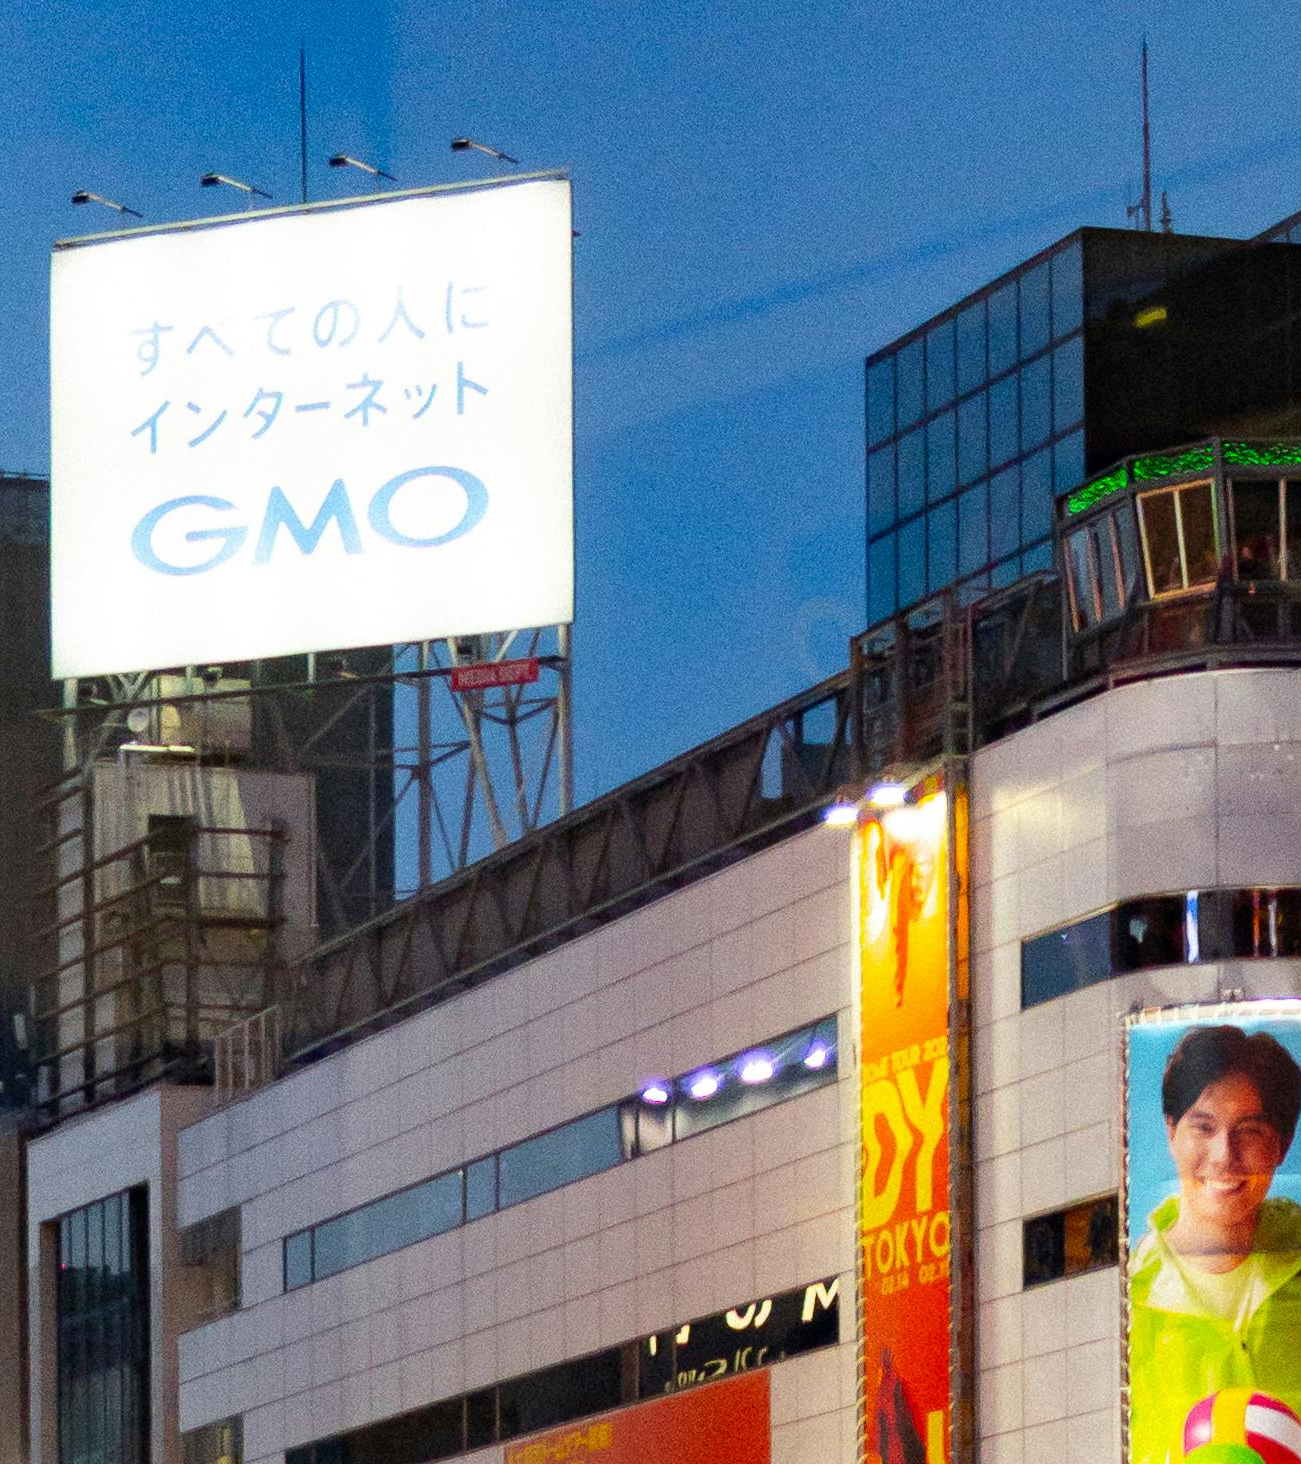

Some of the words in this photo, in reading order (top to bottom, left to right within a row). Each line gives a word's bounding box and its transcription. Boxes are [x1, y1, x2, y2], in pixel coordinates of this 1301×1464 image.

[130, 281, 491, 377] すべての人に
[130, 361, 491, 454] インターネット
[130, 465, 491, 577] GMO
[862, 1212, 950, 1280] TOKYO
